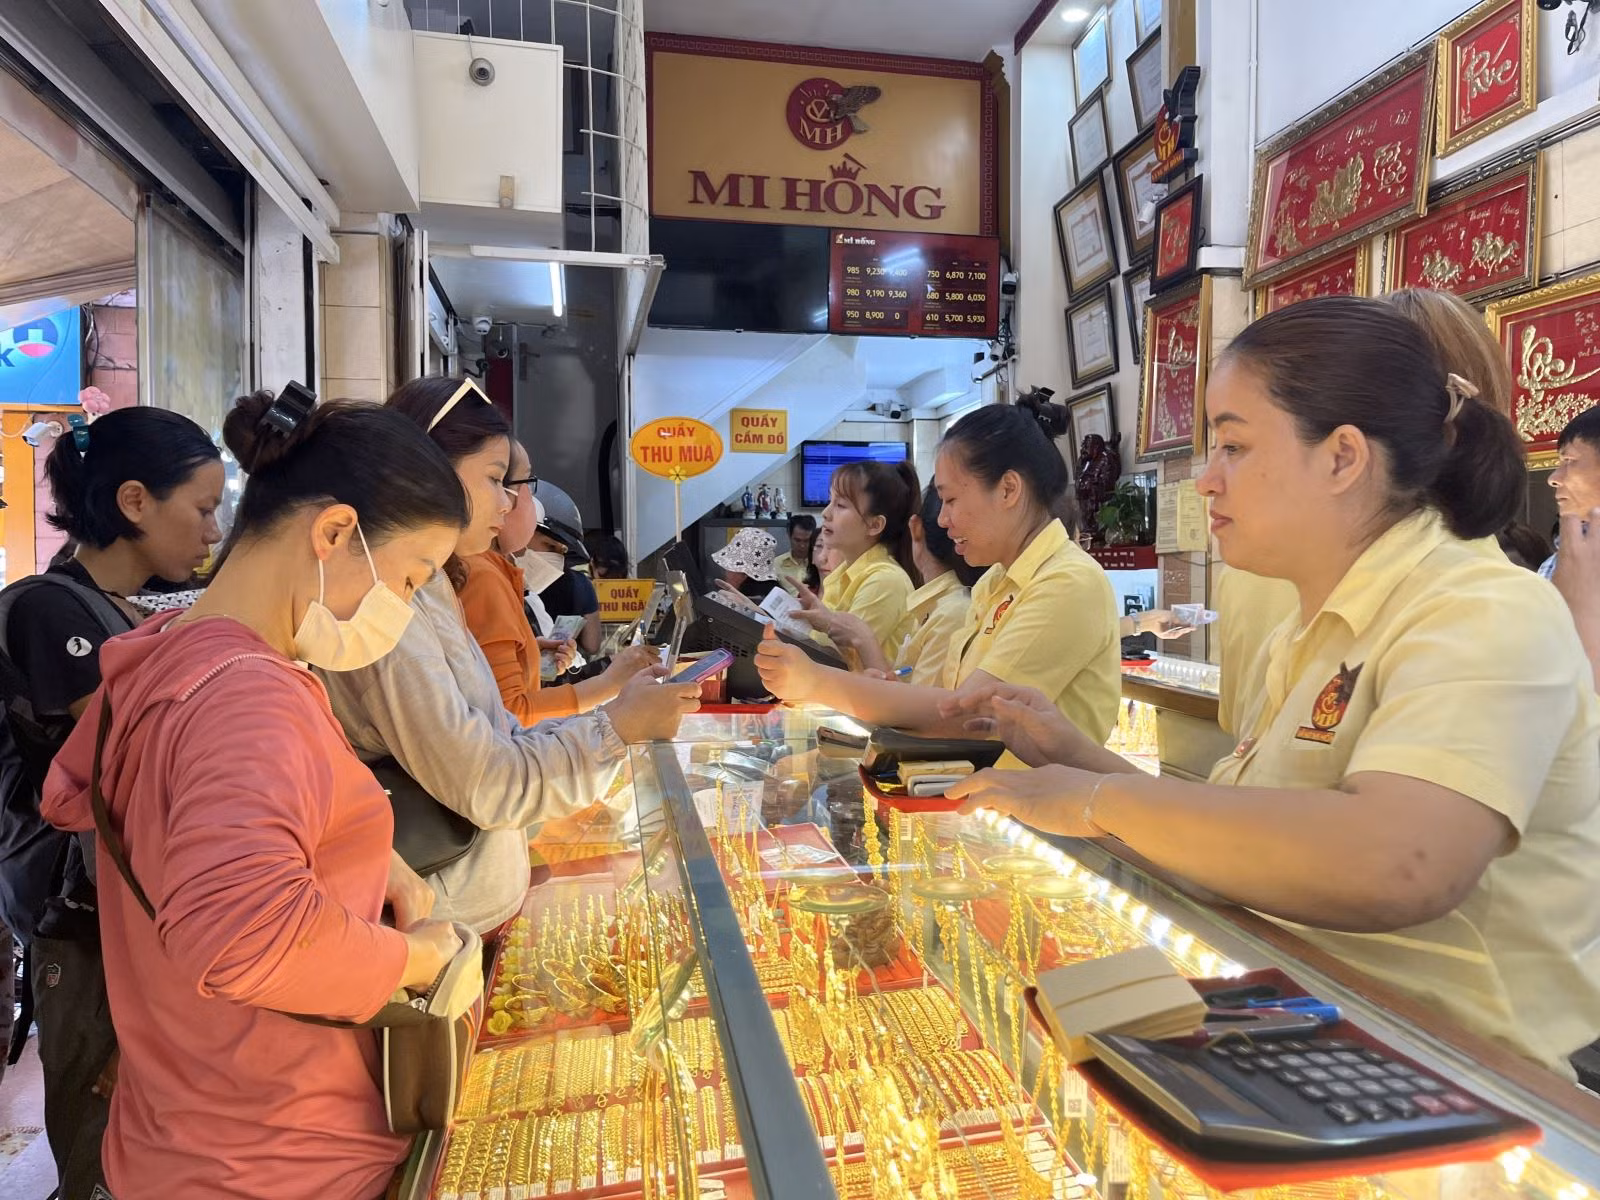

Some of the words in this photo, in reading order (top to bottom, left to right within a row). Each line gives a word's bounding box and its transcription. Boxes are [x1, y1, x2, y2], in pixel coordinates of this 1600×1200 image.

[800, 117, 845, 145] MH
[688, 170, 770, 209] MI
[846, 266, 860, 274] 985
[927, 270, 940, 278] 750
[945, 271, 965, 279] 6,870
[967, 272, 986, 280] 7,100
[846, 288, 860, 296] 980
[866, 289, 885, 298] 9,190
[926, 292, 939, 300] 680
[945, 292, 964, 301] 5,800
[846, 310, 860, 318] 950
[865, 311, 885, 320] 8,900
[894, 312, 900, 320] 0
[926, 313, 939, 321] 610
[945, 314, 964, 323] 5,700
[640, 446, 673, 463] THU
[679, 445, 714, 463] MUA
[599, 602, 618, 612] THU
[622, 600, 647, 612] NGÂ
